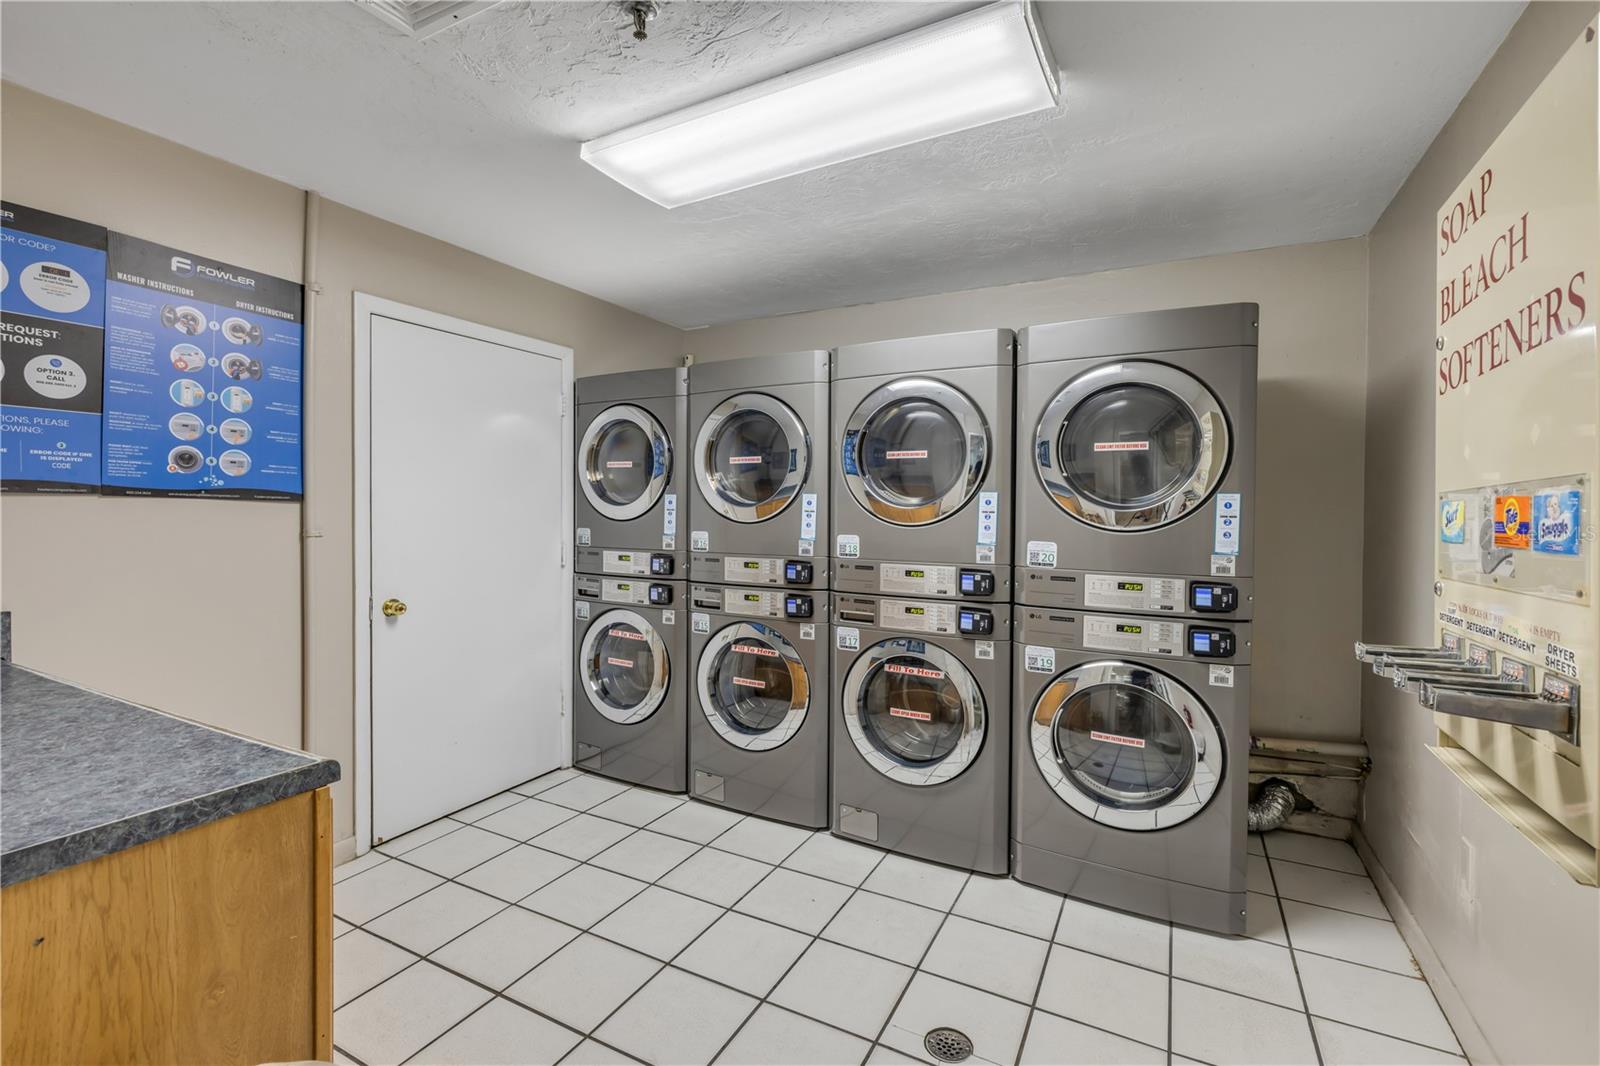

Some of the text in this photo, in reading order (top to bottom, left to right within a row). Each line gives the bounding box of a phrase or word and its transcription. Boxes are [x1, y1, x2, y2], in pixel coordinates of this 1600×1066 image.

[1440, 168, 1493, 257] SOAP
[18, 238, 56, 252] CODE?
[196, 265, 256, 287] FOWLER
[1440, 211, 1529, 326] BLEACH
[117, 271, 145, 286] WASHER
[147, 279, 195, 297] INSTRUCTIONS
[236, 301, 294, 321] DRYER INSTRUCTIONS
[1439, 271, 1586, 396] SOFTENERS
[36, 367, 67, 376] OPTION
[0, 415, 70, 428] IONS, PLEASE
[51, 462, 71, 470] CODE
[1505, 508, 1519, 528] Tide
[1540, 517, 1569, 539] Snuggle
[847, 544, 858, 553] 18
[1041, 553, 1055, 563] 20
[1124, 583, 1143, 591] PUSH
[1439, 612, 1463, 628] DETERGENT
[1123, 625, 1141, 633] PUSH
[1466, 621, 1496, 639] DETERGENT
[848, 637, 858, 646] 17
[1498, 631, 1536, 654] DETERGENT
[757, 648, 776, 656] Here
[1548, 643, 1575, 664] DRYER
[1040, 658, 1053, 668] 19
[1545, 655, 1577, 678] SHEETS
[918, 668, 941, 677] Here
